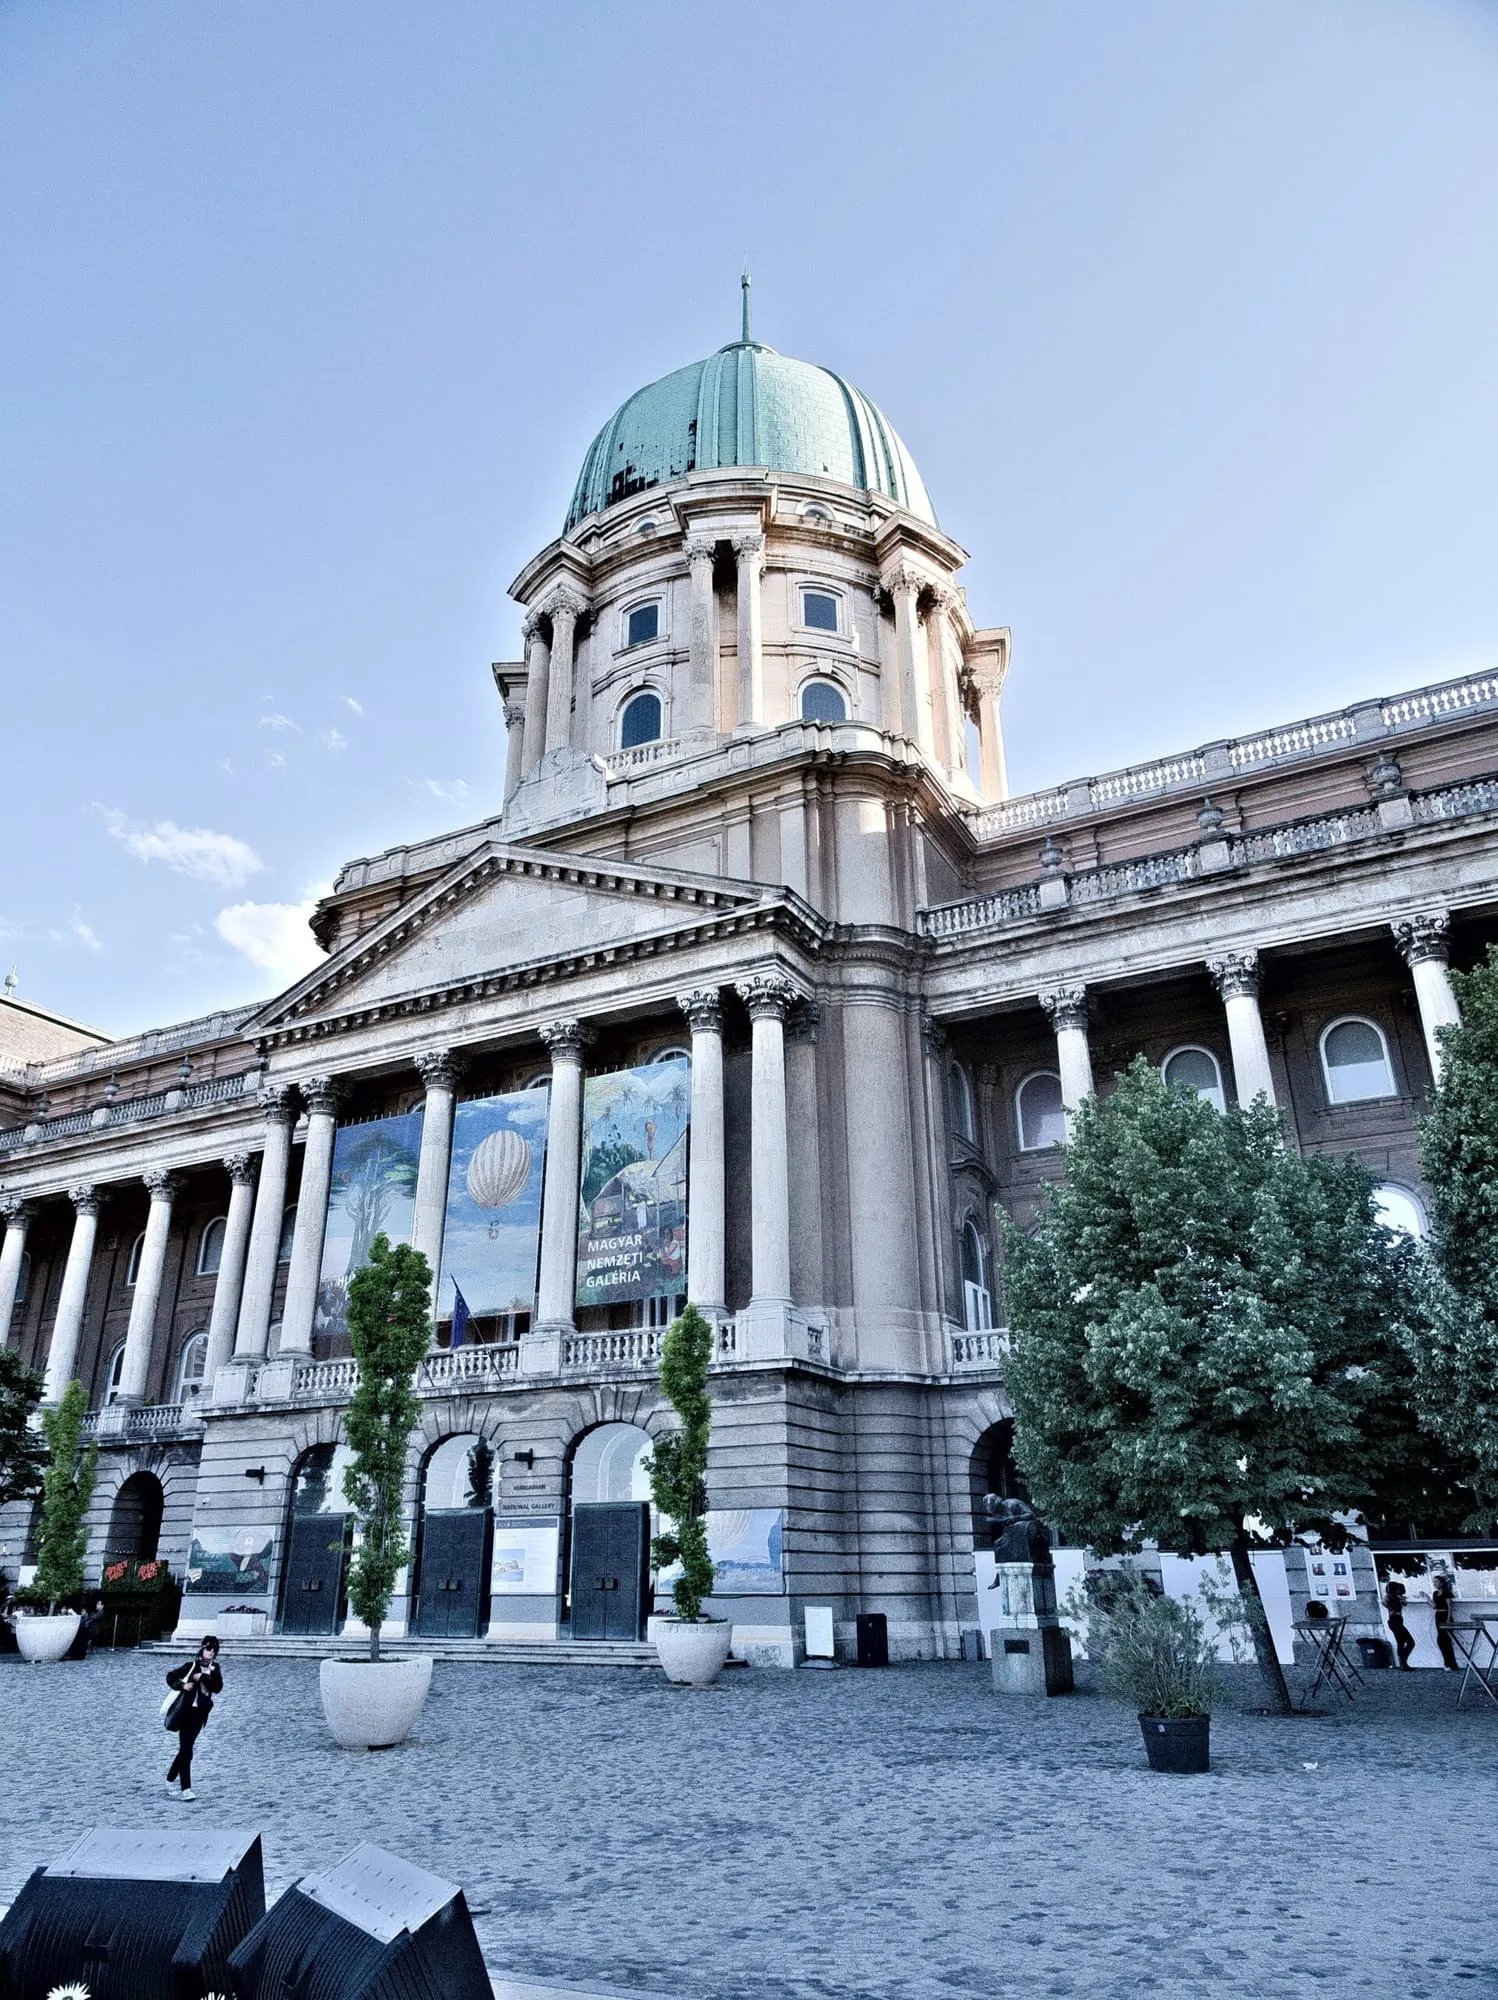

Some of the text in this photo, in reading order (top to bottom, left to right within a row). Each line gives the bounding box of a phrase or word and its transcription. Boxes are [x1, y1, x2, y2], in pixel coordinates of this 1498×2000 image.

[587, 1234, 642, 1253] MAGYAR
[586, 1252, 643, 1270] NEMZETI
[586, 1270, 641, 1288] GALÉRIA
